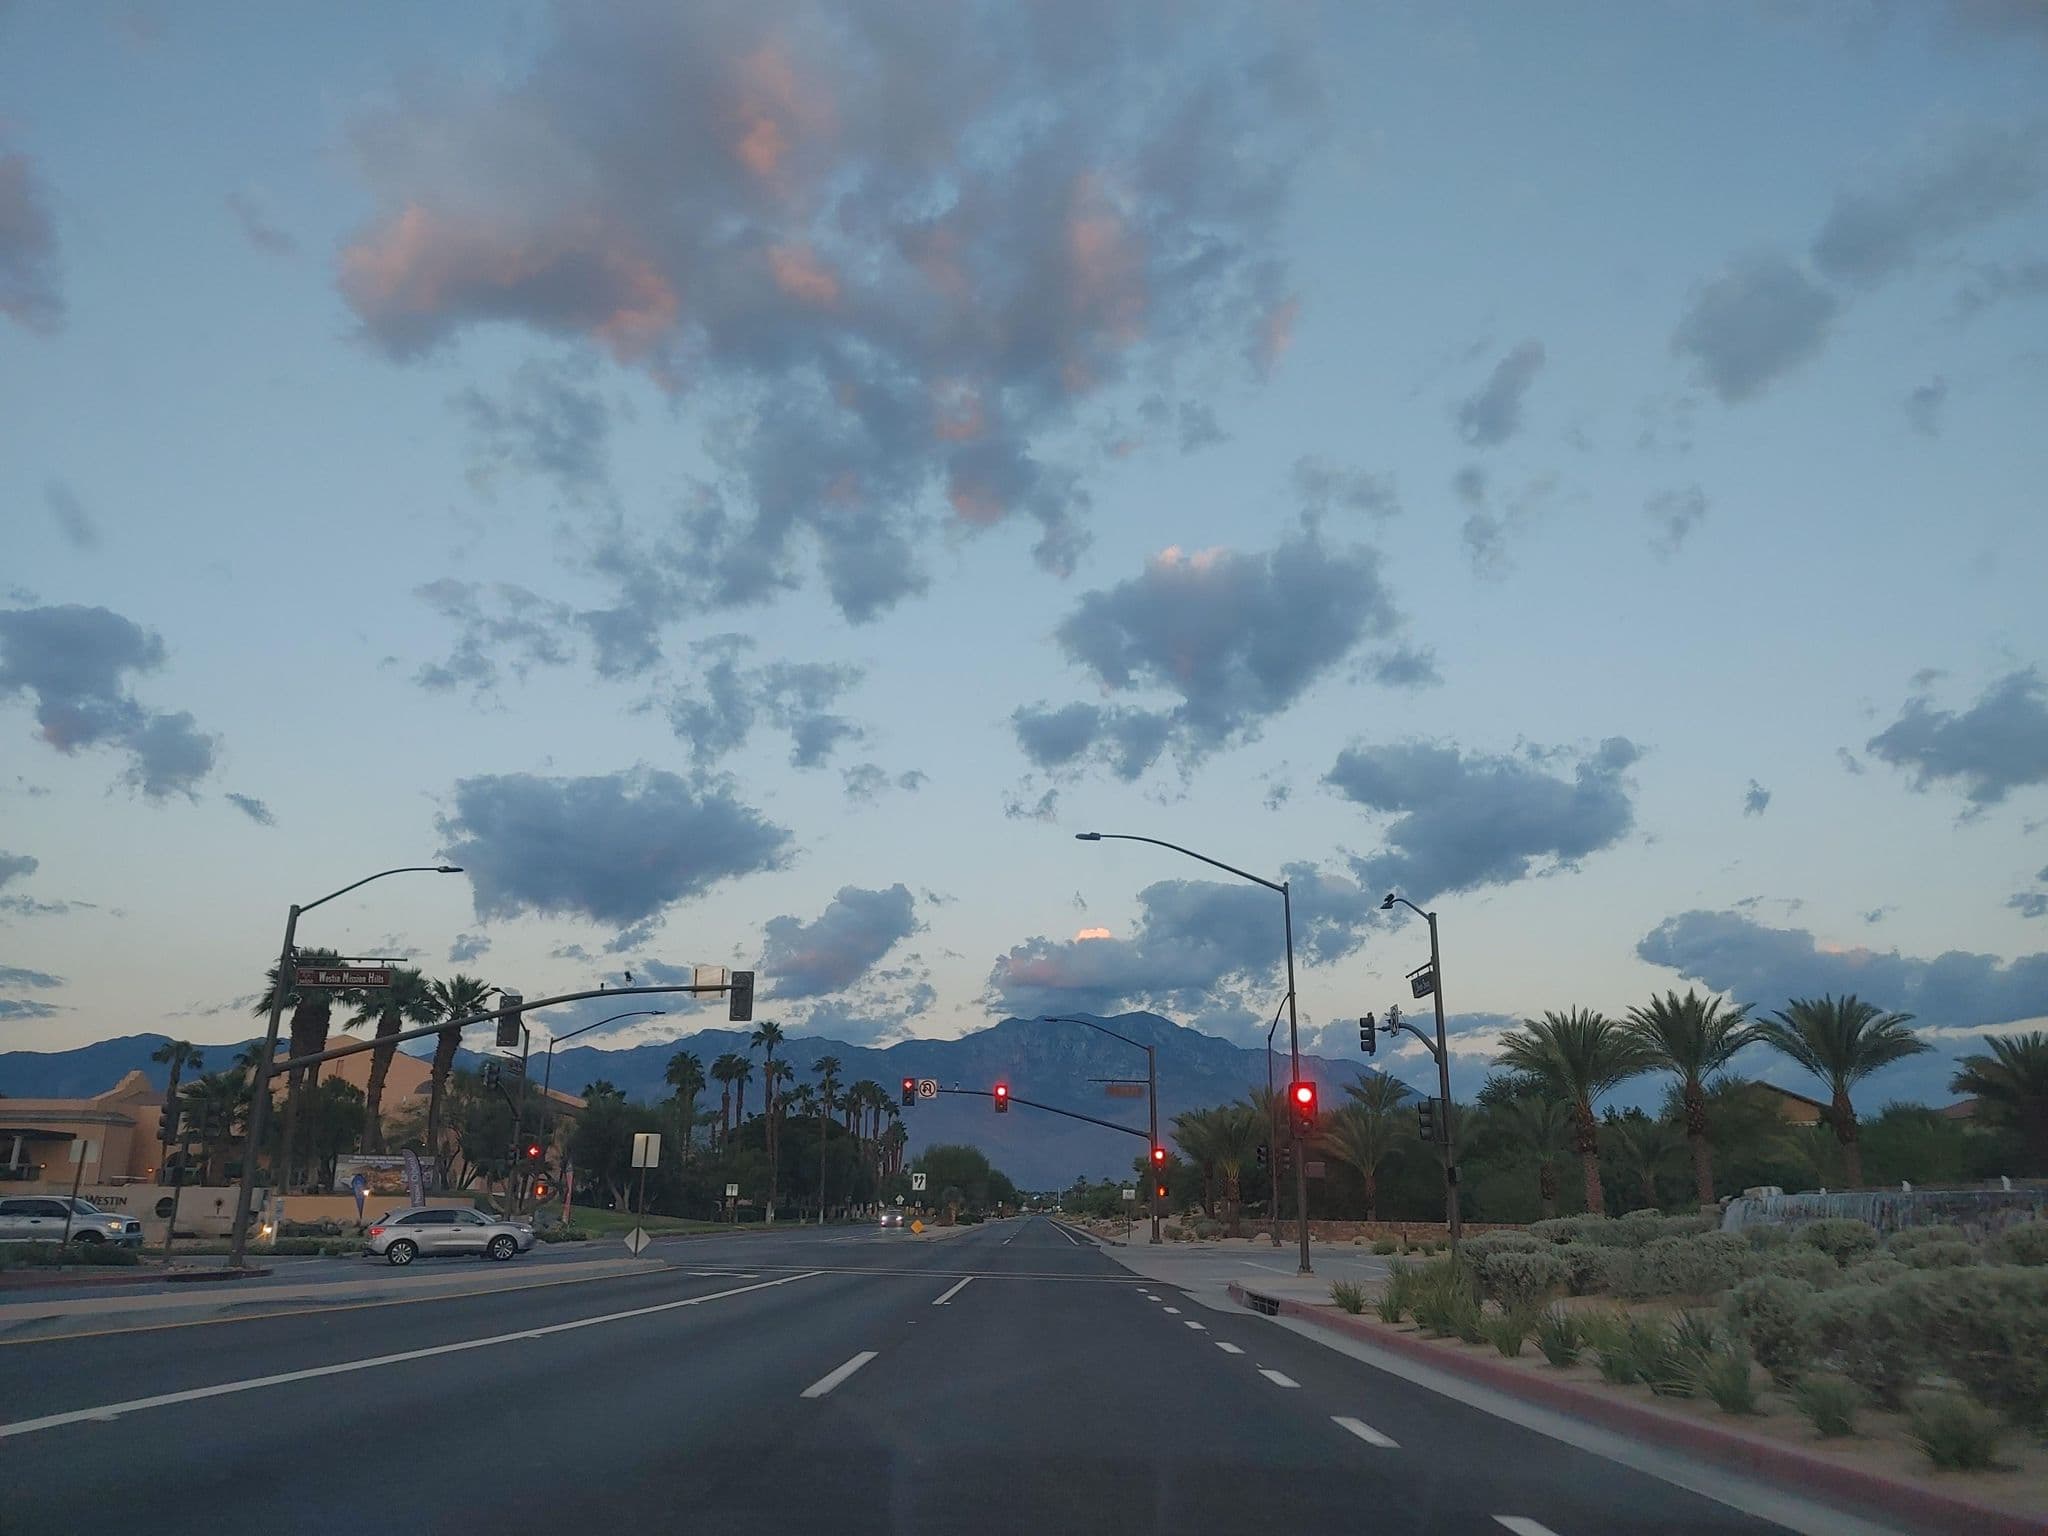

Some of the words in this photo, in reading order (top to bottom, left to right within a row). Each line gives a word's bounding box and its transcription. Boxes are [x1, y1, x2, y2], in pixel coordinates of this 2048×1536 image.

[319, 971, 341, 983] Westin
[342, 971, 366, 983] Mission
[368, 971, 384, 983] Hills
